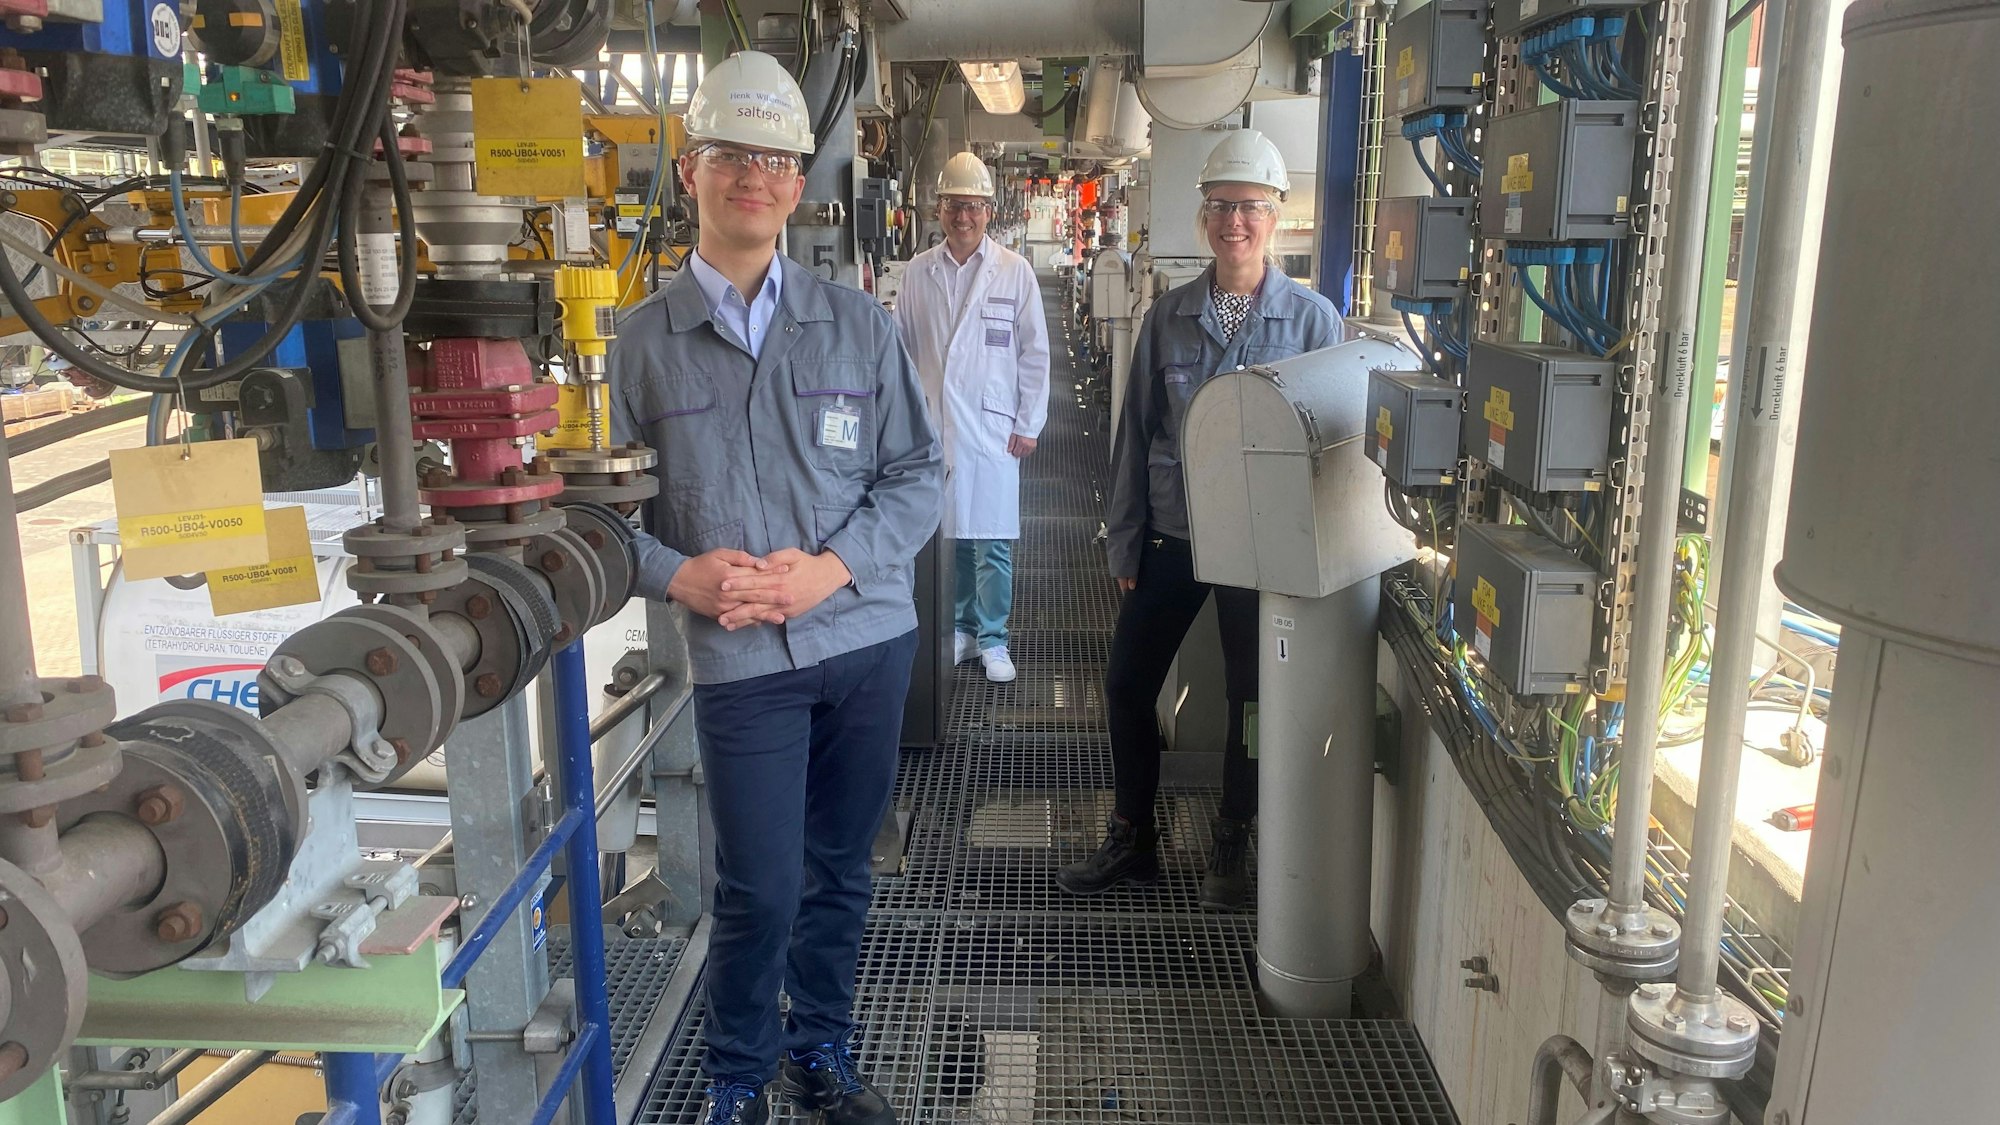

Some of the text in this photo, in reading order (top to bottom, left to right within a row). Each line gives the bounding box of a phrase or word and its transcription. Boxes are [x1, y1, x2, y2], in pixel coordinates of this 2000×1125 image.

[730, 92, 751, 100] Henk
[737, 105, 781, 122] saltigo
[490, 149, 566, 158] R500-UB04-V0051
[813, 245, 838, 281] 5
[1678, 332, 1690, 347] bar
[1776, 346, 1788, 363] bar
[1674, 356, 1687, 398] Druckluft
[1769, 373, 1784, 421] Druckluft
[841, 420, 858, 442] M
[140, 517, 243, 537] R500-UB04-V0050
[222, 566, 298, 583] R500-UB04-V0081
[1274, 616, 1293, 628] UB 05
[144, 625, 206, 638] ENTZÜNDBARER
[207, 629, 251, 641] FLÜSSIGER
[229, 643, 268, 657] TOLUENE)
